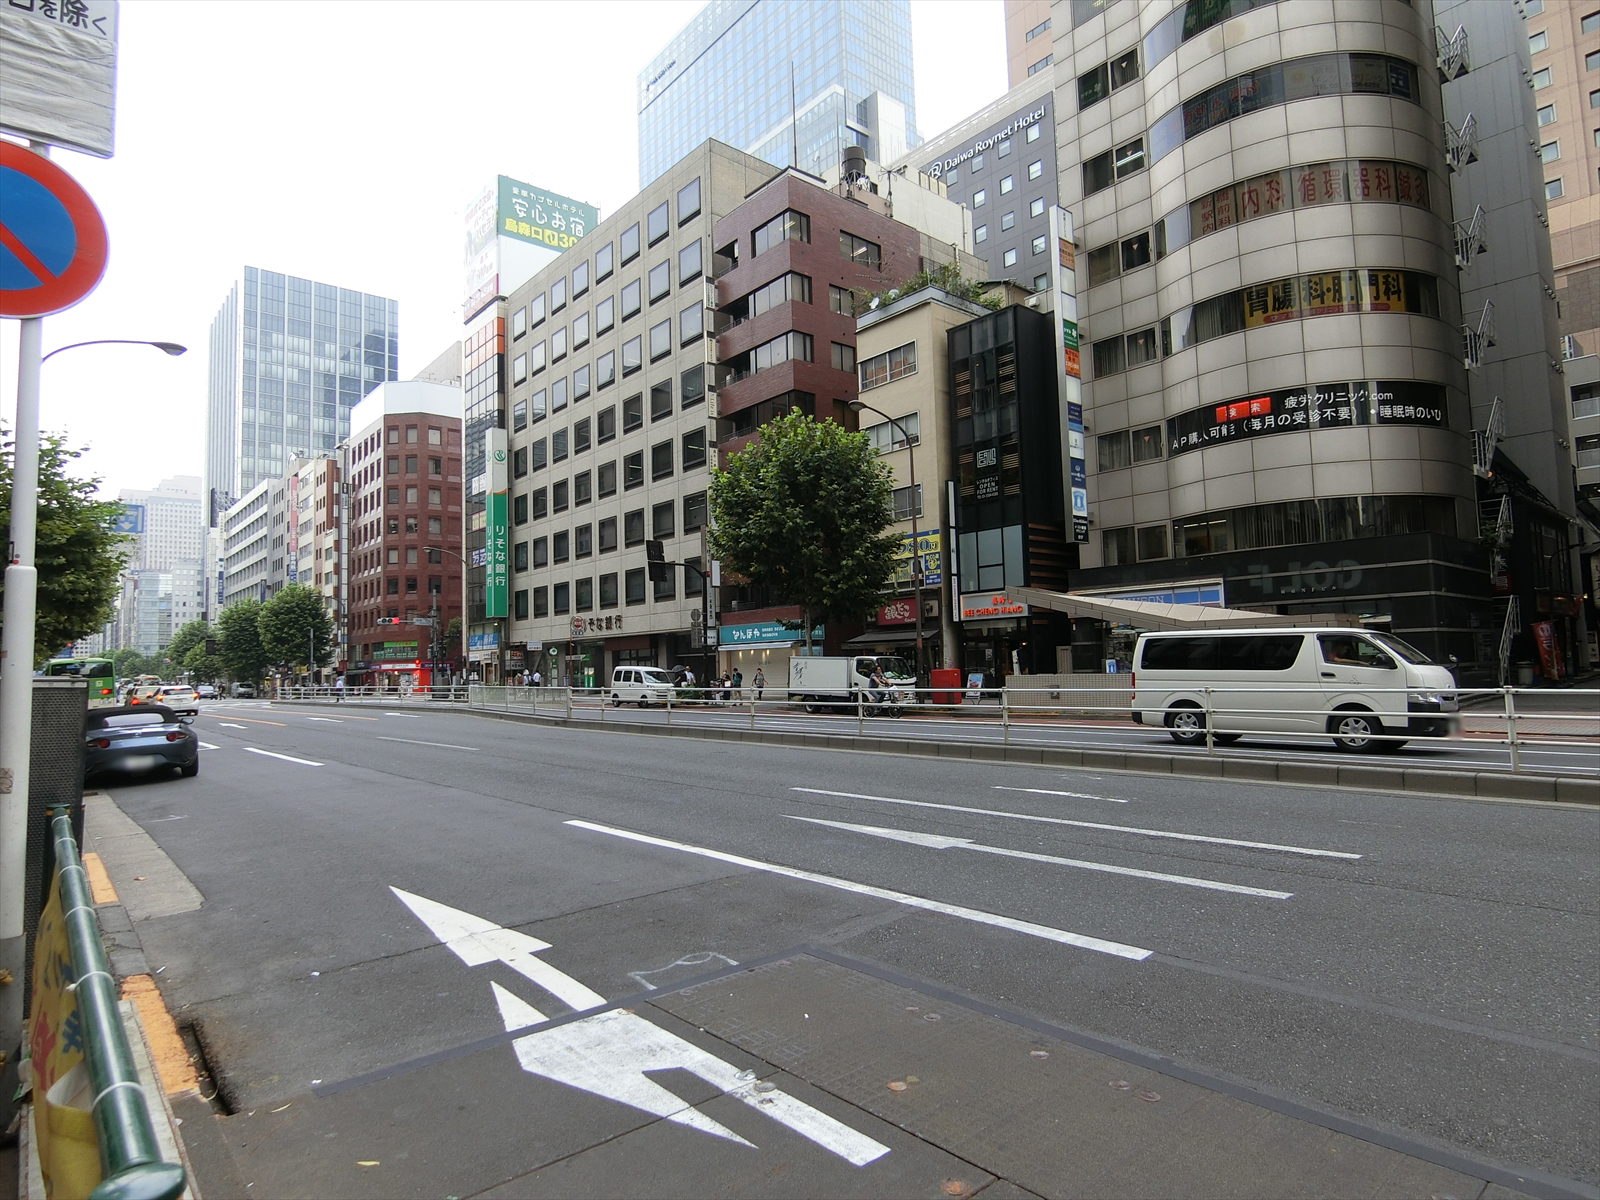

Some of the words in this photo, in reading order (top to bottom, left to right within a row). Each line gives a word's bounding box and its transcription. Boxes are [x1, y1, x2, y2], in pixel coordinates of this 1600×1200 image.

[944, 148, 974, 171] Daiwa
[975, 125, 1013, 155] Roynet
[1014, 105, 1046, 132] Hotel
[1241, 177, 1285, 218] 内科
[1297, 166, 1393, 202] 循環器科
[512, 197, 585, 238] 安心お宿
[979, 481, 996, 490] OPEN
[987, 485, 999, 493] RENT
[495, 524, 506, 587] りそな銀行
[884, 601, 910, 620] 銀だこ
[963, 609, 975, 617] BEE
[975, 607, 999, 616] CHENG
[1000, 604, 1023, 614] HIANG
